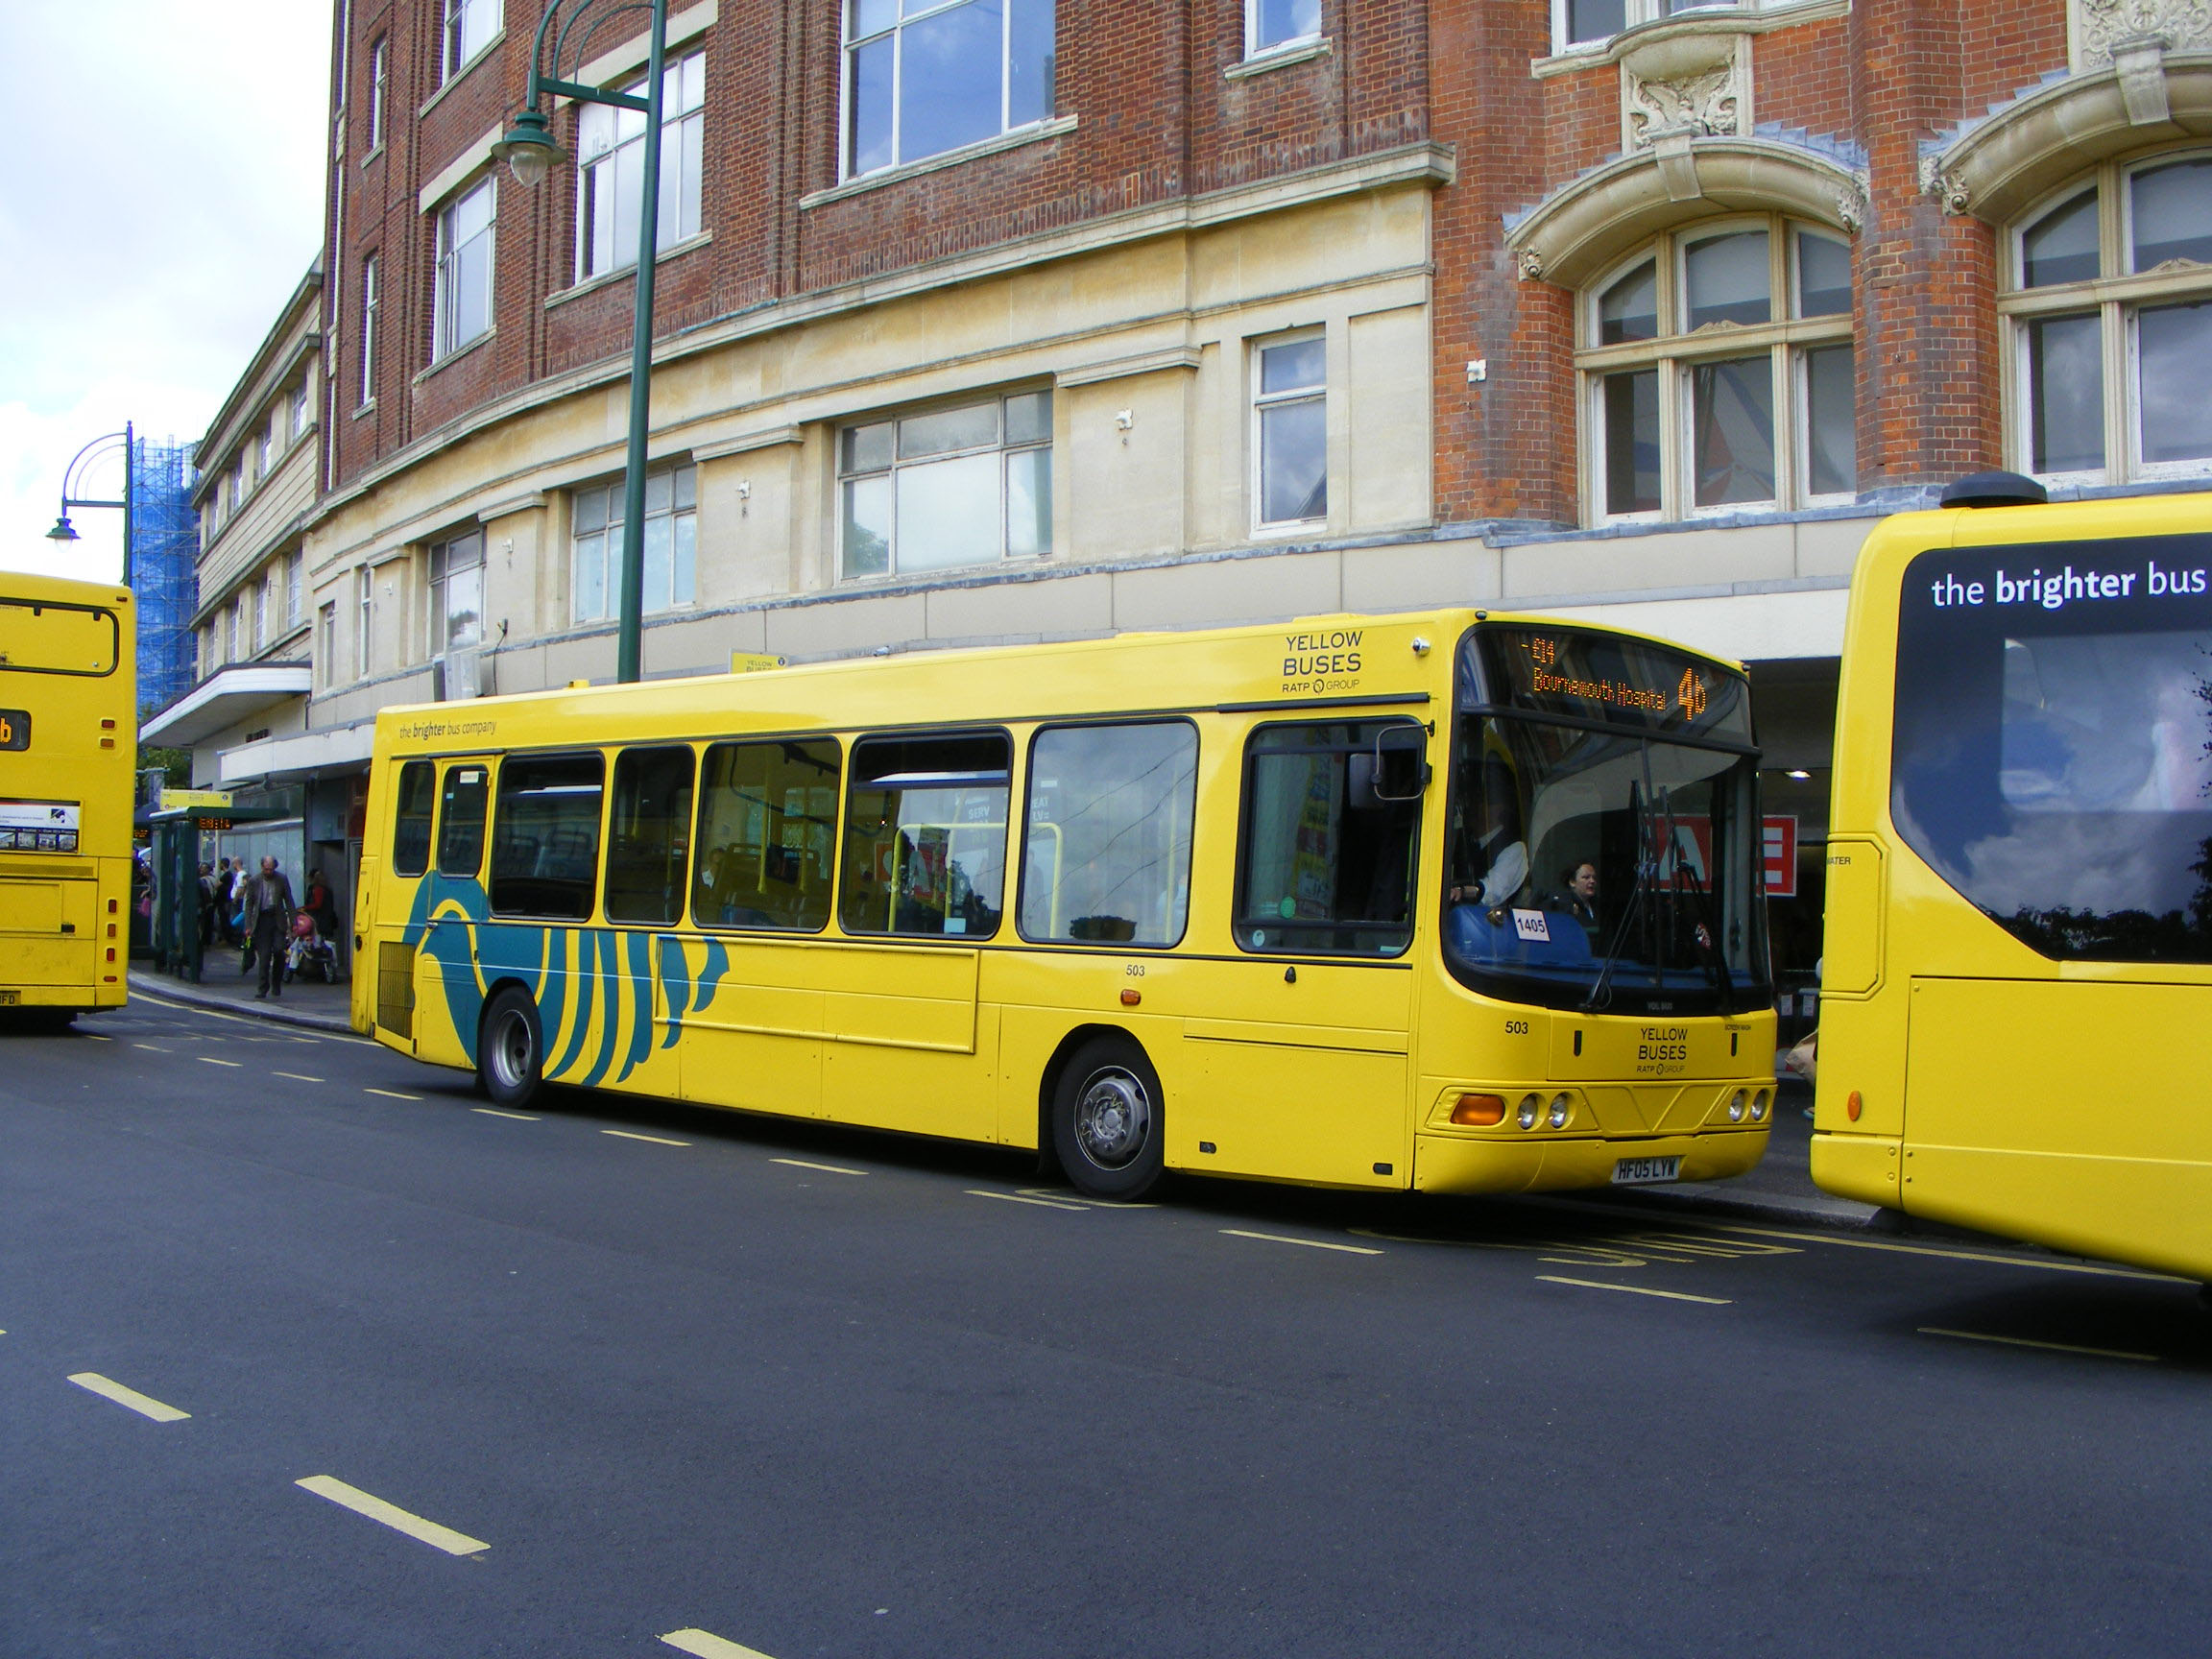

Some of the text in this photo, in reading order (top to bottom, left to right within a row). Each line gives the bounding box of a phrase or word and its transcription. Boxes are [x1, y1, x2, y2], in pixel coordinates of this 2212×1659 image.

[1932, 562, 2206, 609] the brighter bus
[1286, 631, 1362, 651] YELLOW
[1284, 653, 1361, 676] BUSES
[1283, 680, 1359, 692] RATP GROUP
[1534, 667, 1666, 709] Bournemouth Hospital
[1679, 668, 1706, 720] 4b
[399, 720, 496, 740] the brighter bus company
[1518, 918, 1545, 933] 1405
[1126, 964, 1145, 976] 503
[1505, 1022, 1528, 1034] 503
[1641, 1028, 1688, 1041] YELLOW
[1638, 1046, 1686, 1060] BUSES
[1618, 1158, 1676, 1179] HF05 LYW
